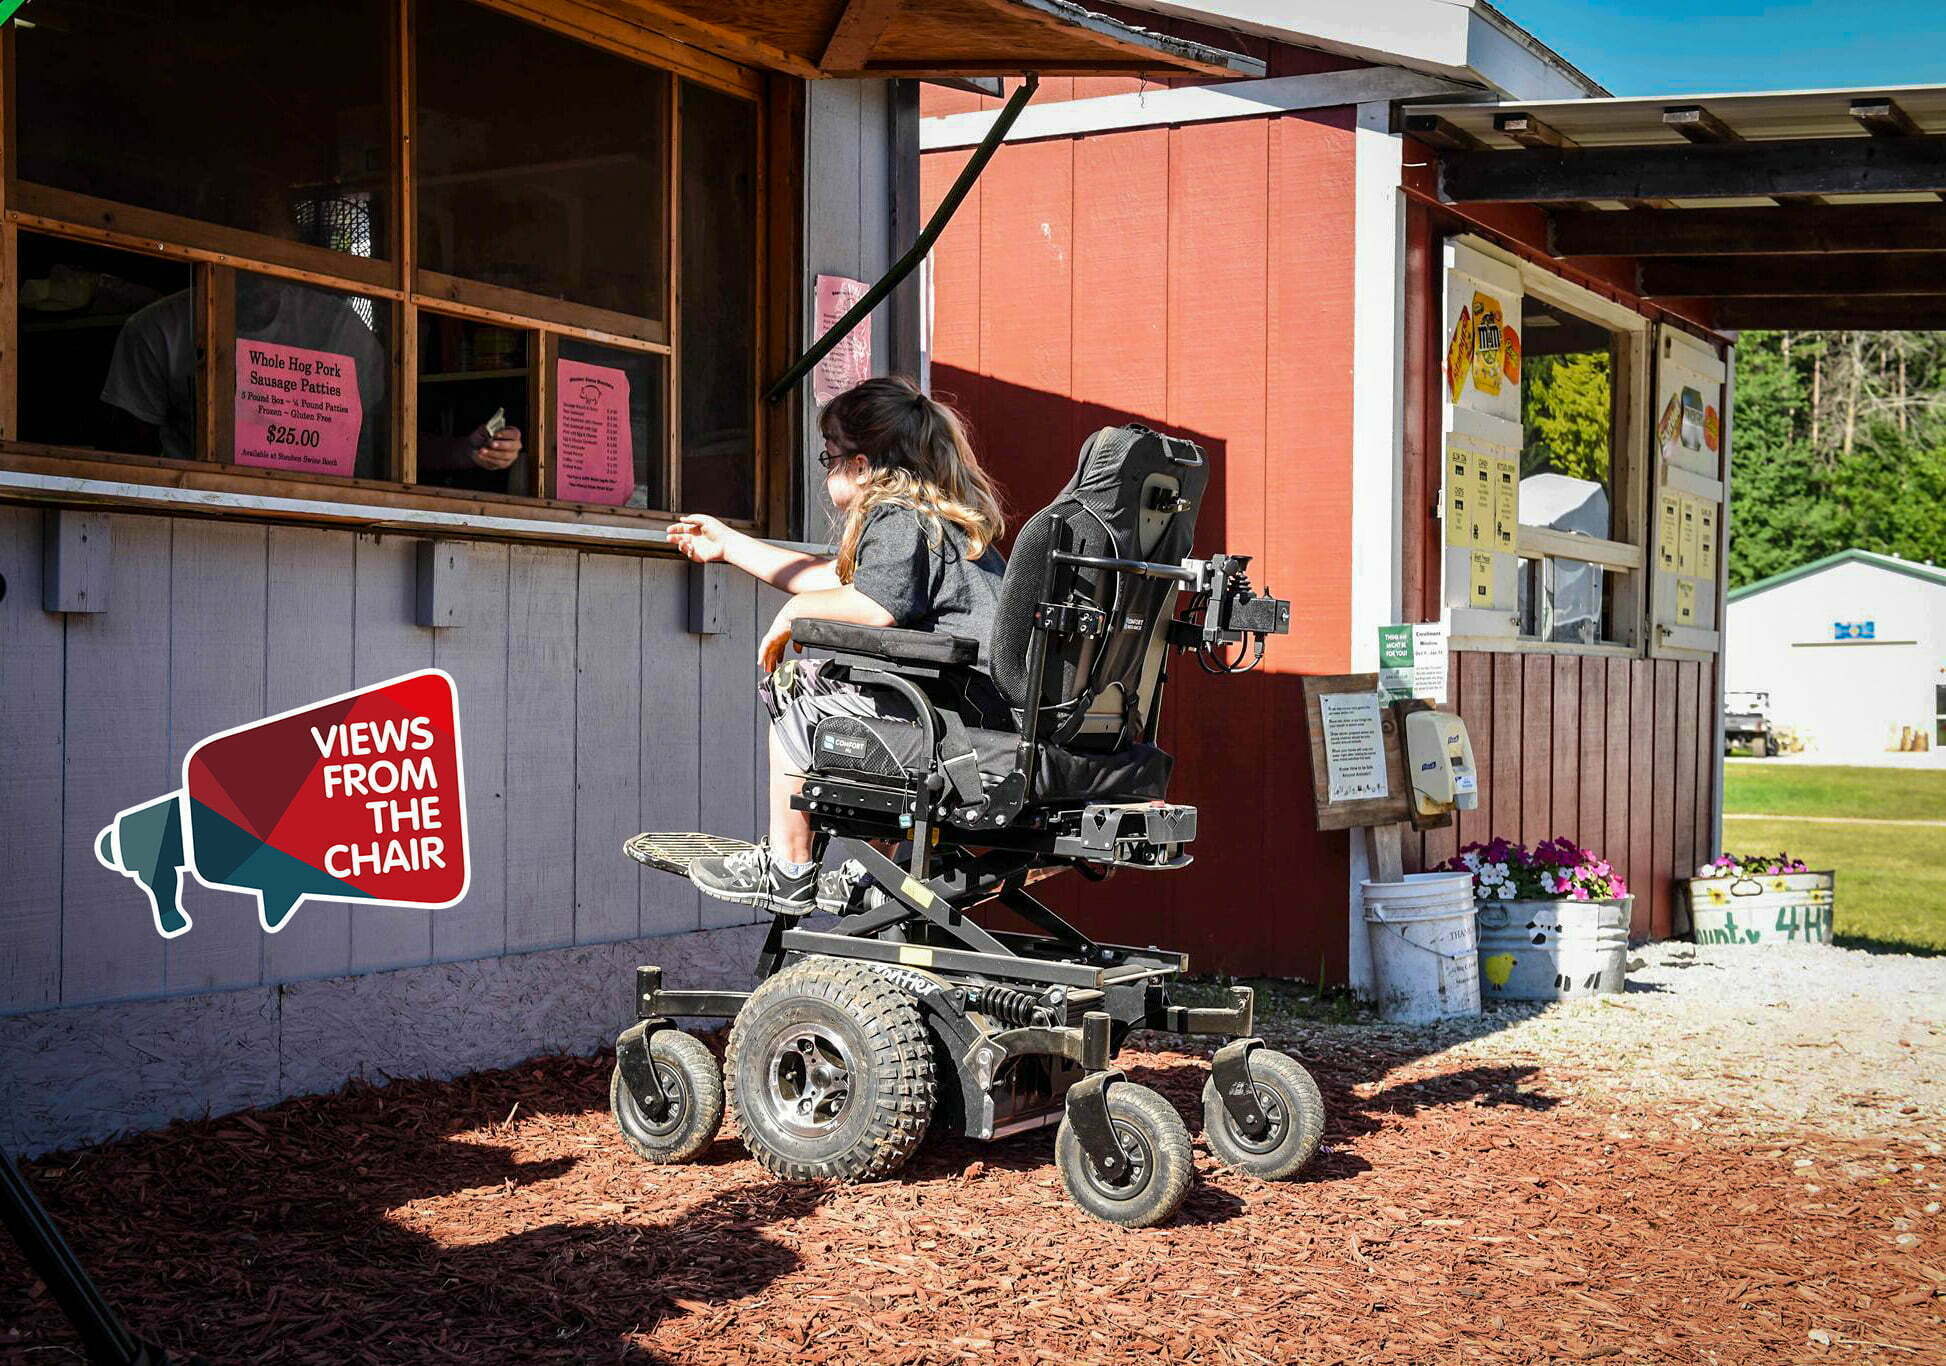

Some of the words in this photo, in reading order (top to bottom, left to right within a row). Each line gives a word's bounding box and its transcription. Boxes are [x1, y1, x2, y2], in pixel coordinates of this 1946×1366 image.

[249, 350, 285, 369] Whole
[288, 356, 312, 375] Hog
[315, 360, 342, 377] Pork
[250, 371, 297, 391] Sausage
[301, 379, 341, 397] Patties
[241, 391, 246, 400] 5
[247, 391, 270, 404] Pound
[271, 394, 285, 405] Box
[301, 399, 324, 411] Pound
[325, 403, 349, 414] Patties
[258, 405, 282, 417] Frozen
[290, 409, 315, 421] Gluten
[316, 412, 332, 423] Free
[266, 424, 320, 448] $25.00
[241, 448, 269, 459] Available
[835, 738, 865, 751] COMFORT
